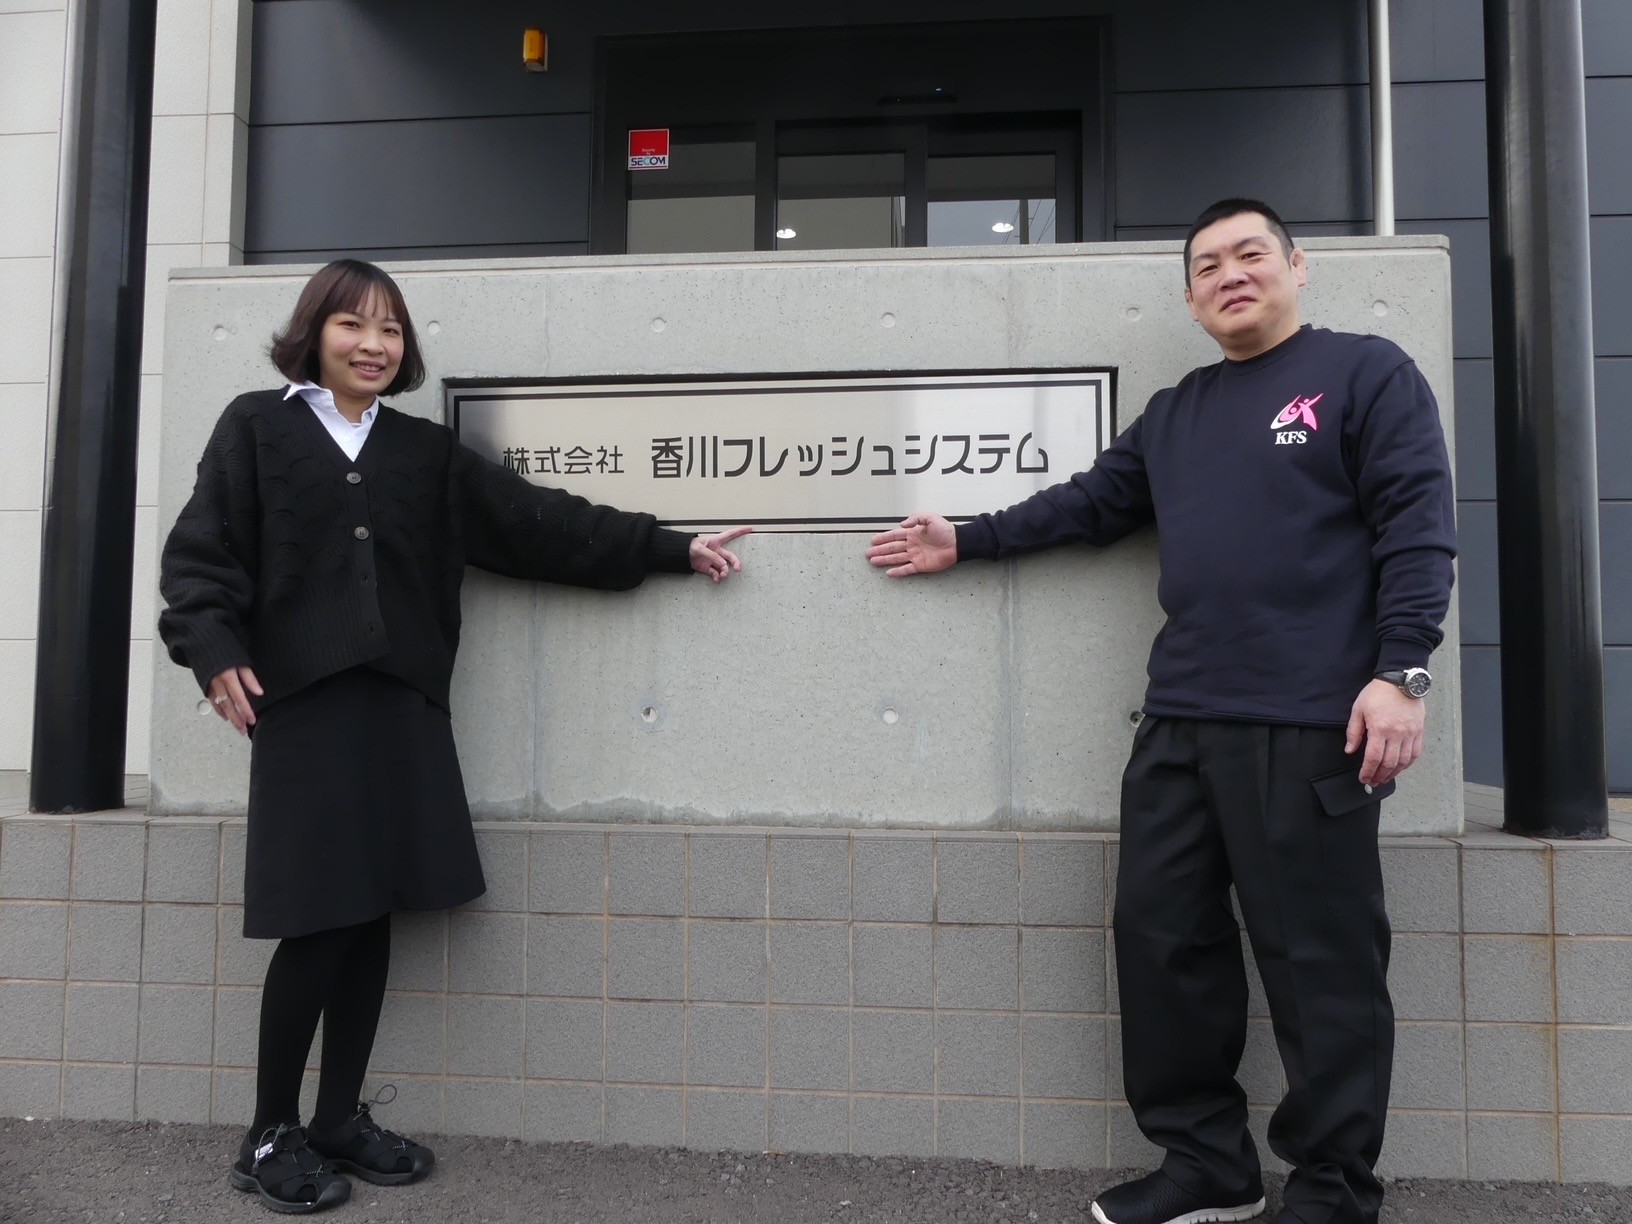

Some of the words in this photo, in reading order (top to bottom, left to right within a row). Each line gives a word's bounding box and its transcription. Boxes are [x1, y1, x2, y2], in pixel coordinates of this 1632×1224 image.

[631, 157, 666, 166] SECOM
[1275, 430, 1307, 445] KFS
[503, 445, 625, 475] 株式会社
[651, 432, 1049, 478] 香川フレッシュシステム
